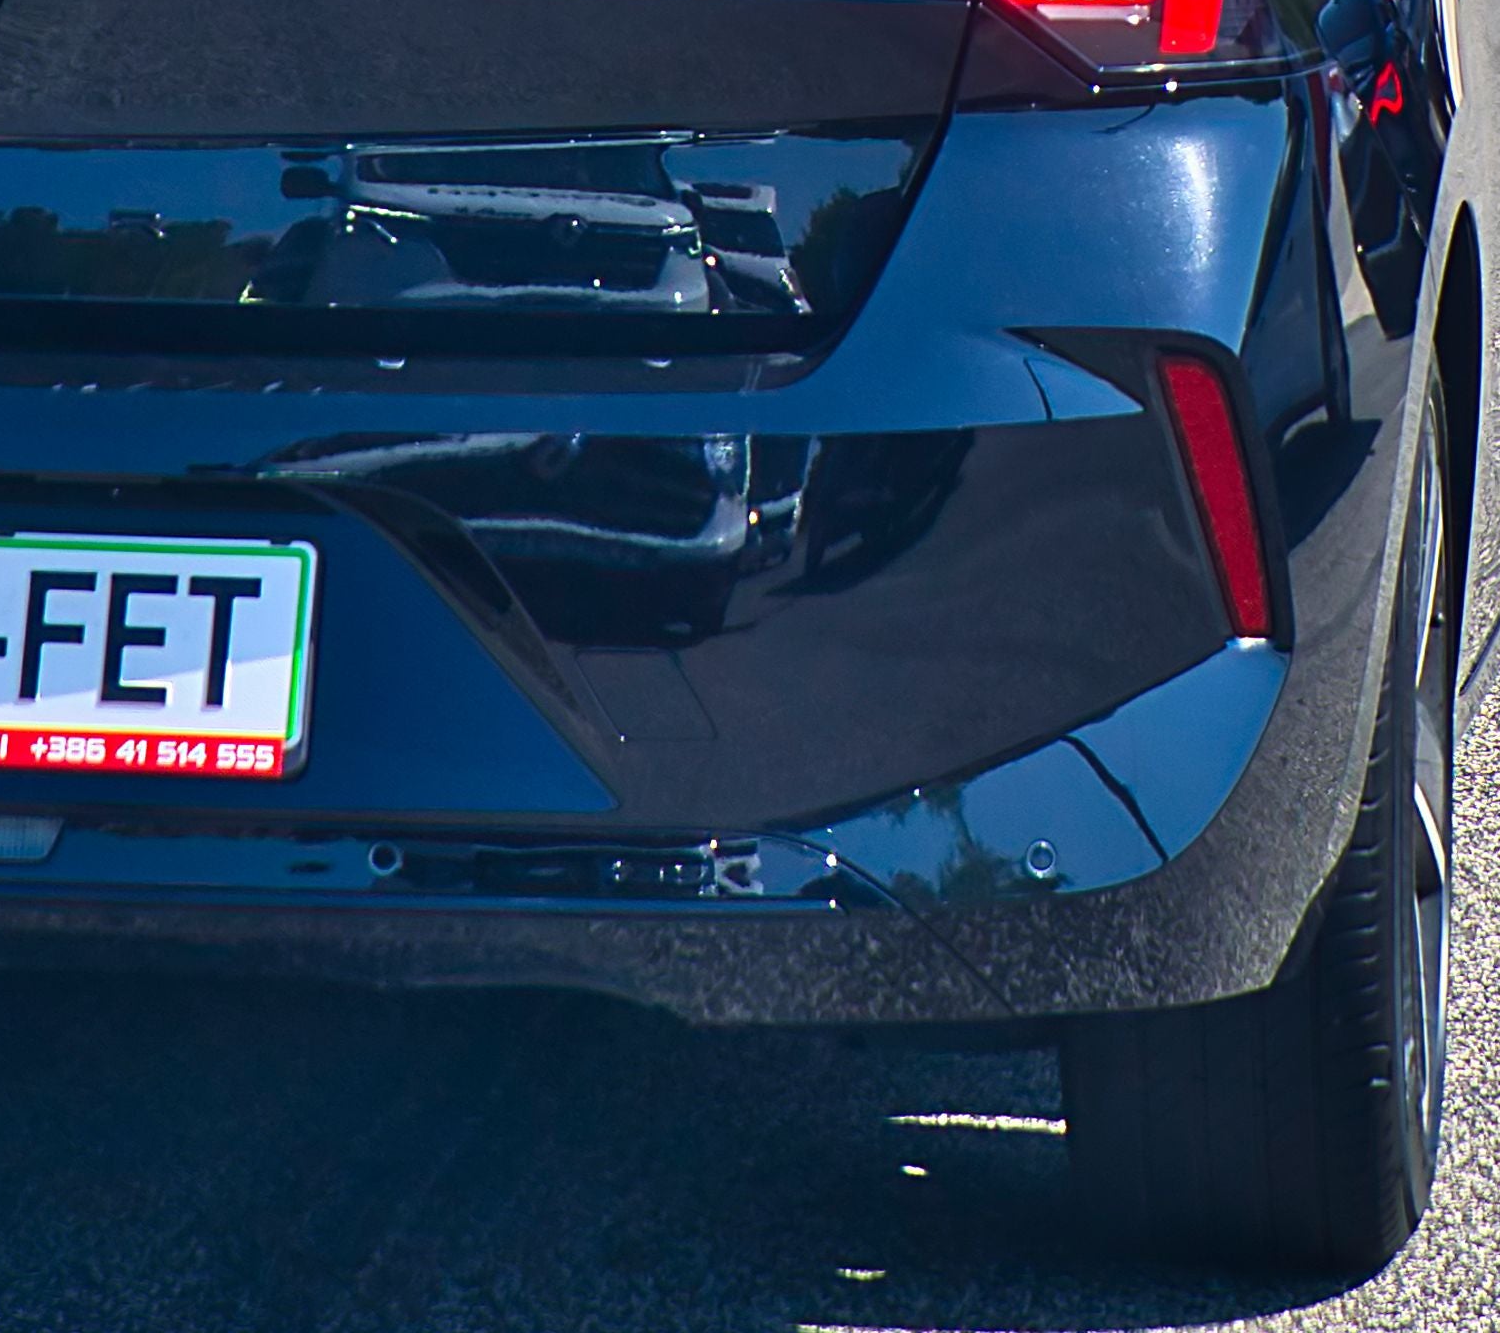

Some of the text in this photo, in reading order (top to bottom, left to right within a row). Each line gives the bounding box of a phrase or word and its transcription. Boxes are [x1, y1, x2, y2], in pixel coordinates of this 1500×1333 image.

[114, 738, 148, 765] 41
[156, 739, 207, 768] 514
[215, 742, 275, 771] 555
